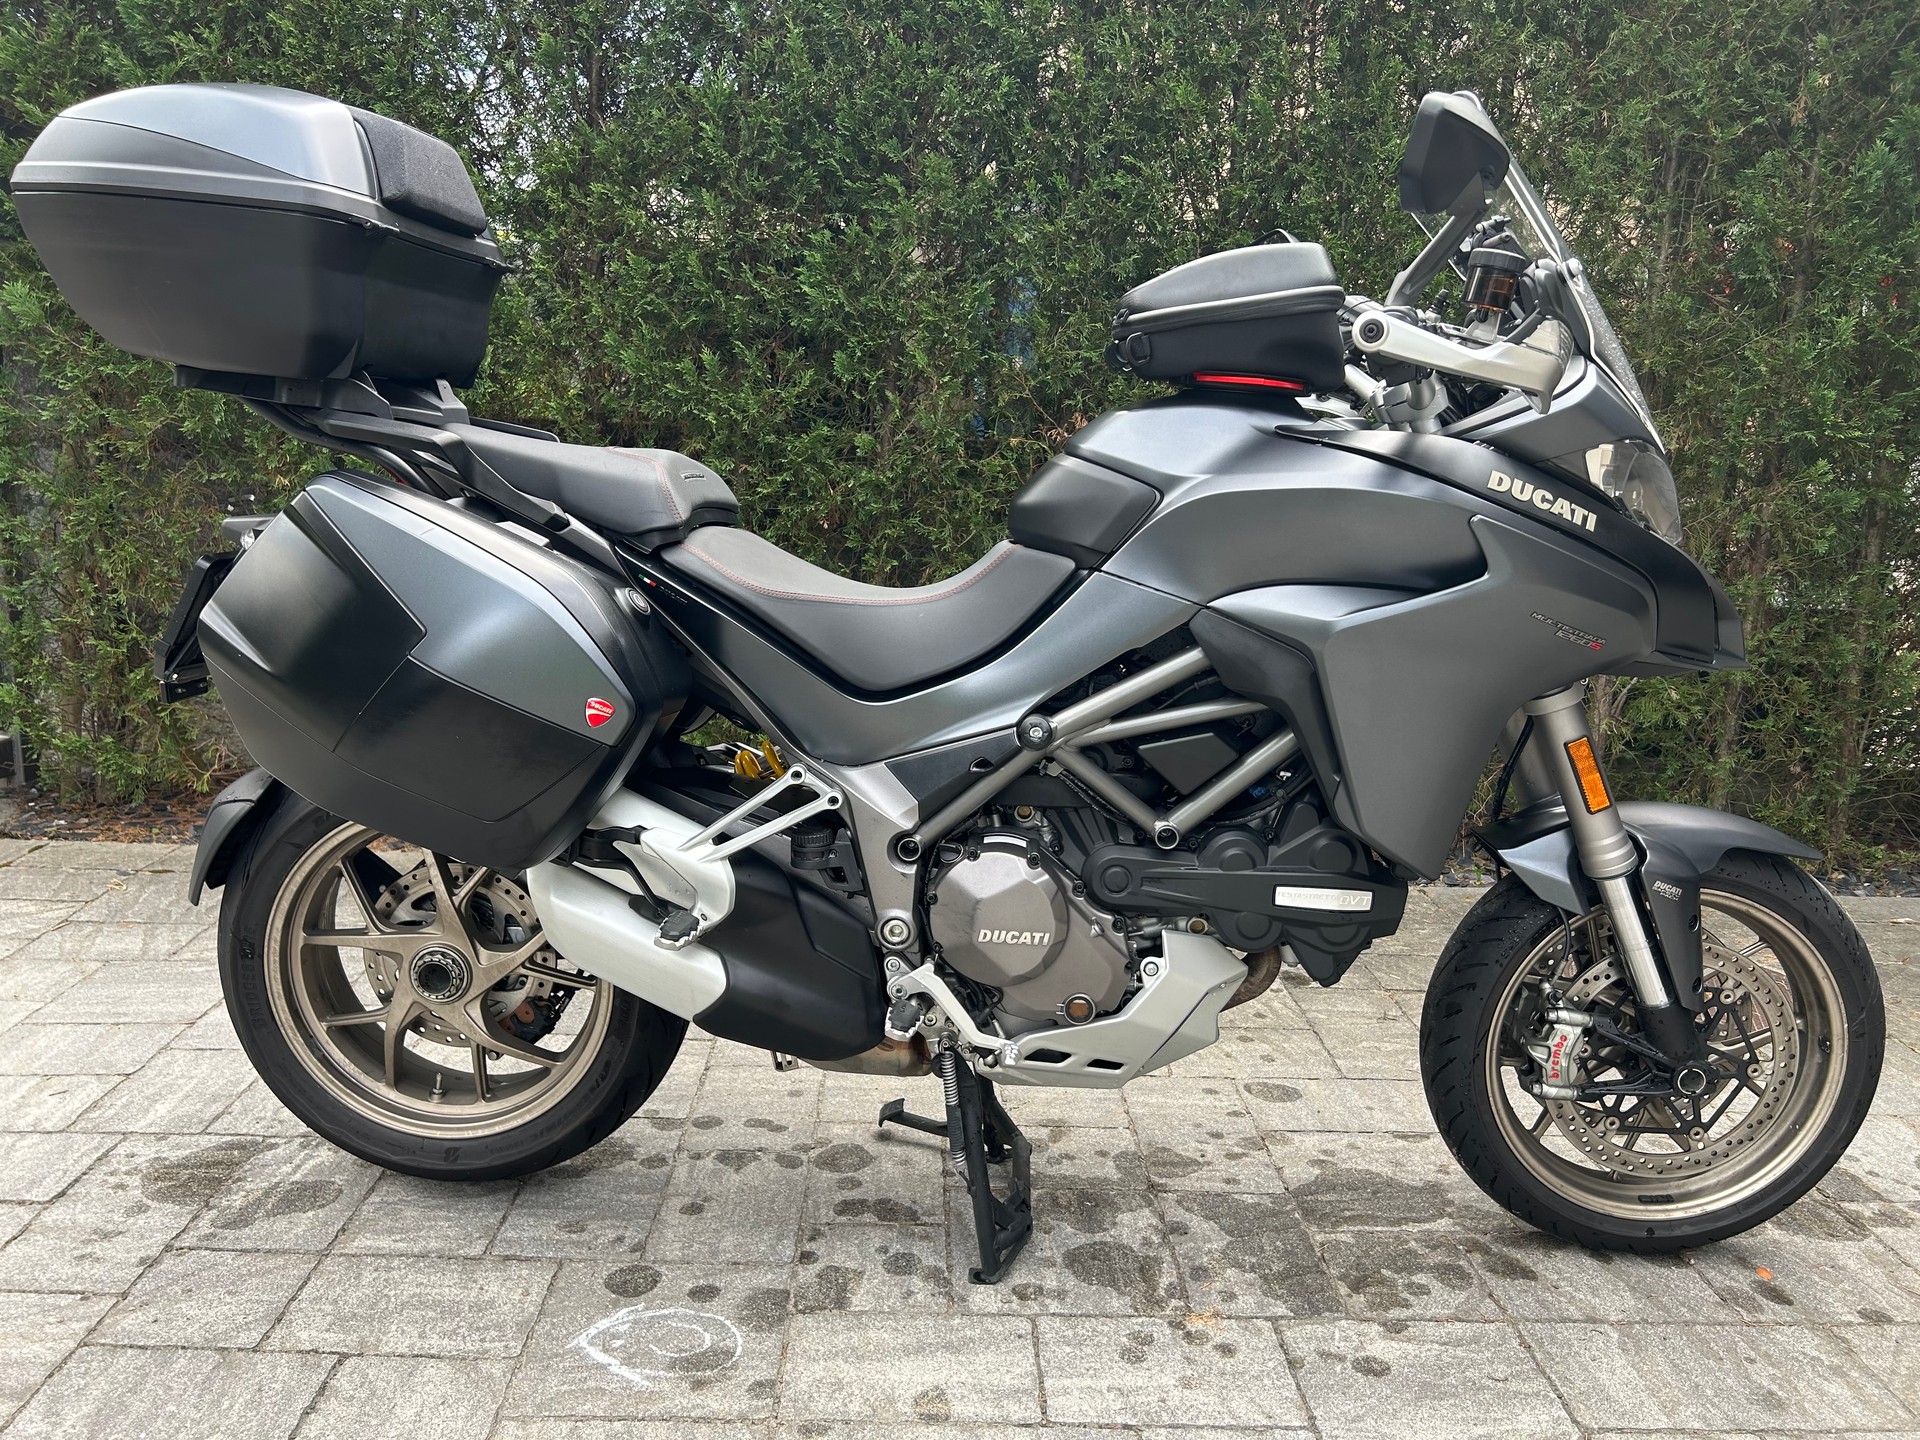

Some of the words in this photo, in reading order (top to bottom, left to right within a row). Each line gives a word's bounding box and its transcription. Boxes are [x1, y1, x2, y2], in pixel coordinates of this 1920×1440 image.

[1487, 470, 1597, 532] DUCATI
[1531, 612, 1606, 644] MULTISTRADA
[1555, 629, 1605, 651] 1260S
[590, 701, 613, 714] DUCATI
[1653, 880, 1682, 896] DUCATI
[978, 929, 1050, 946] DUCATI
[1549, 1034, 1568, 1079] brembo
